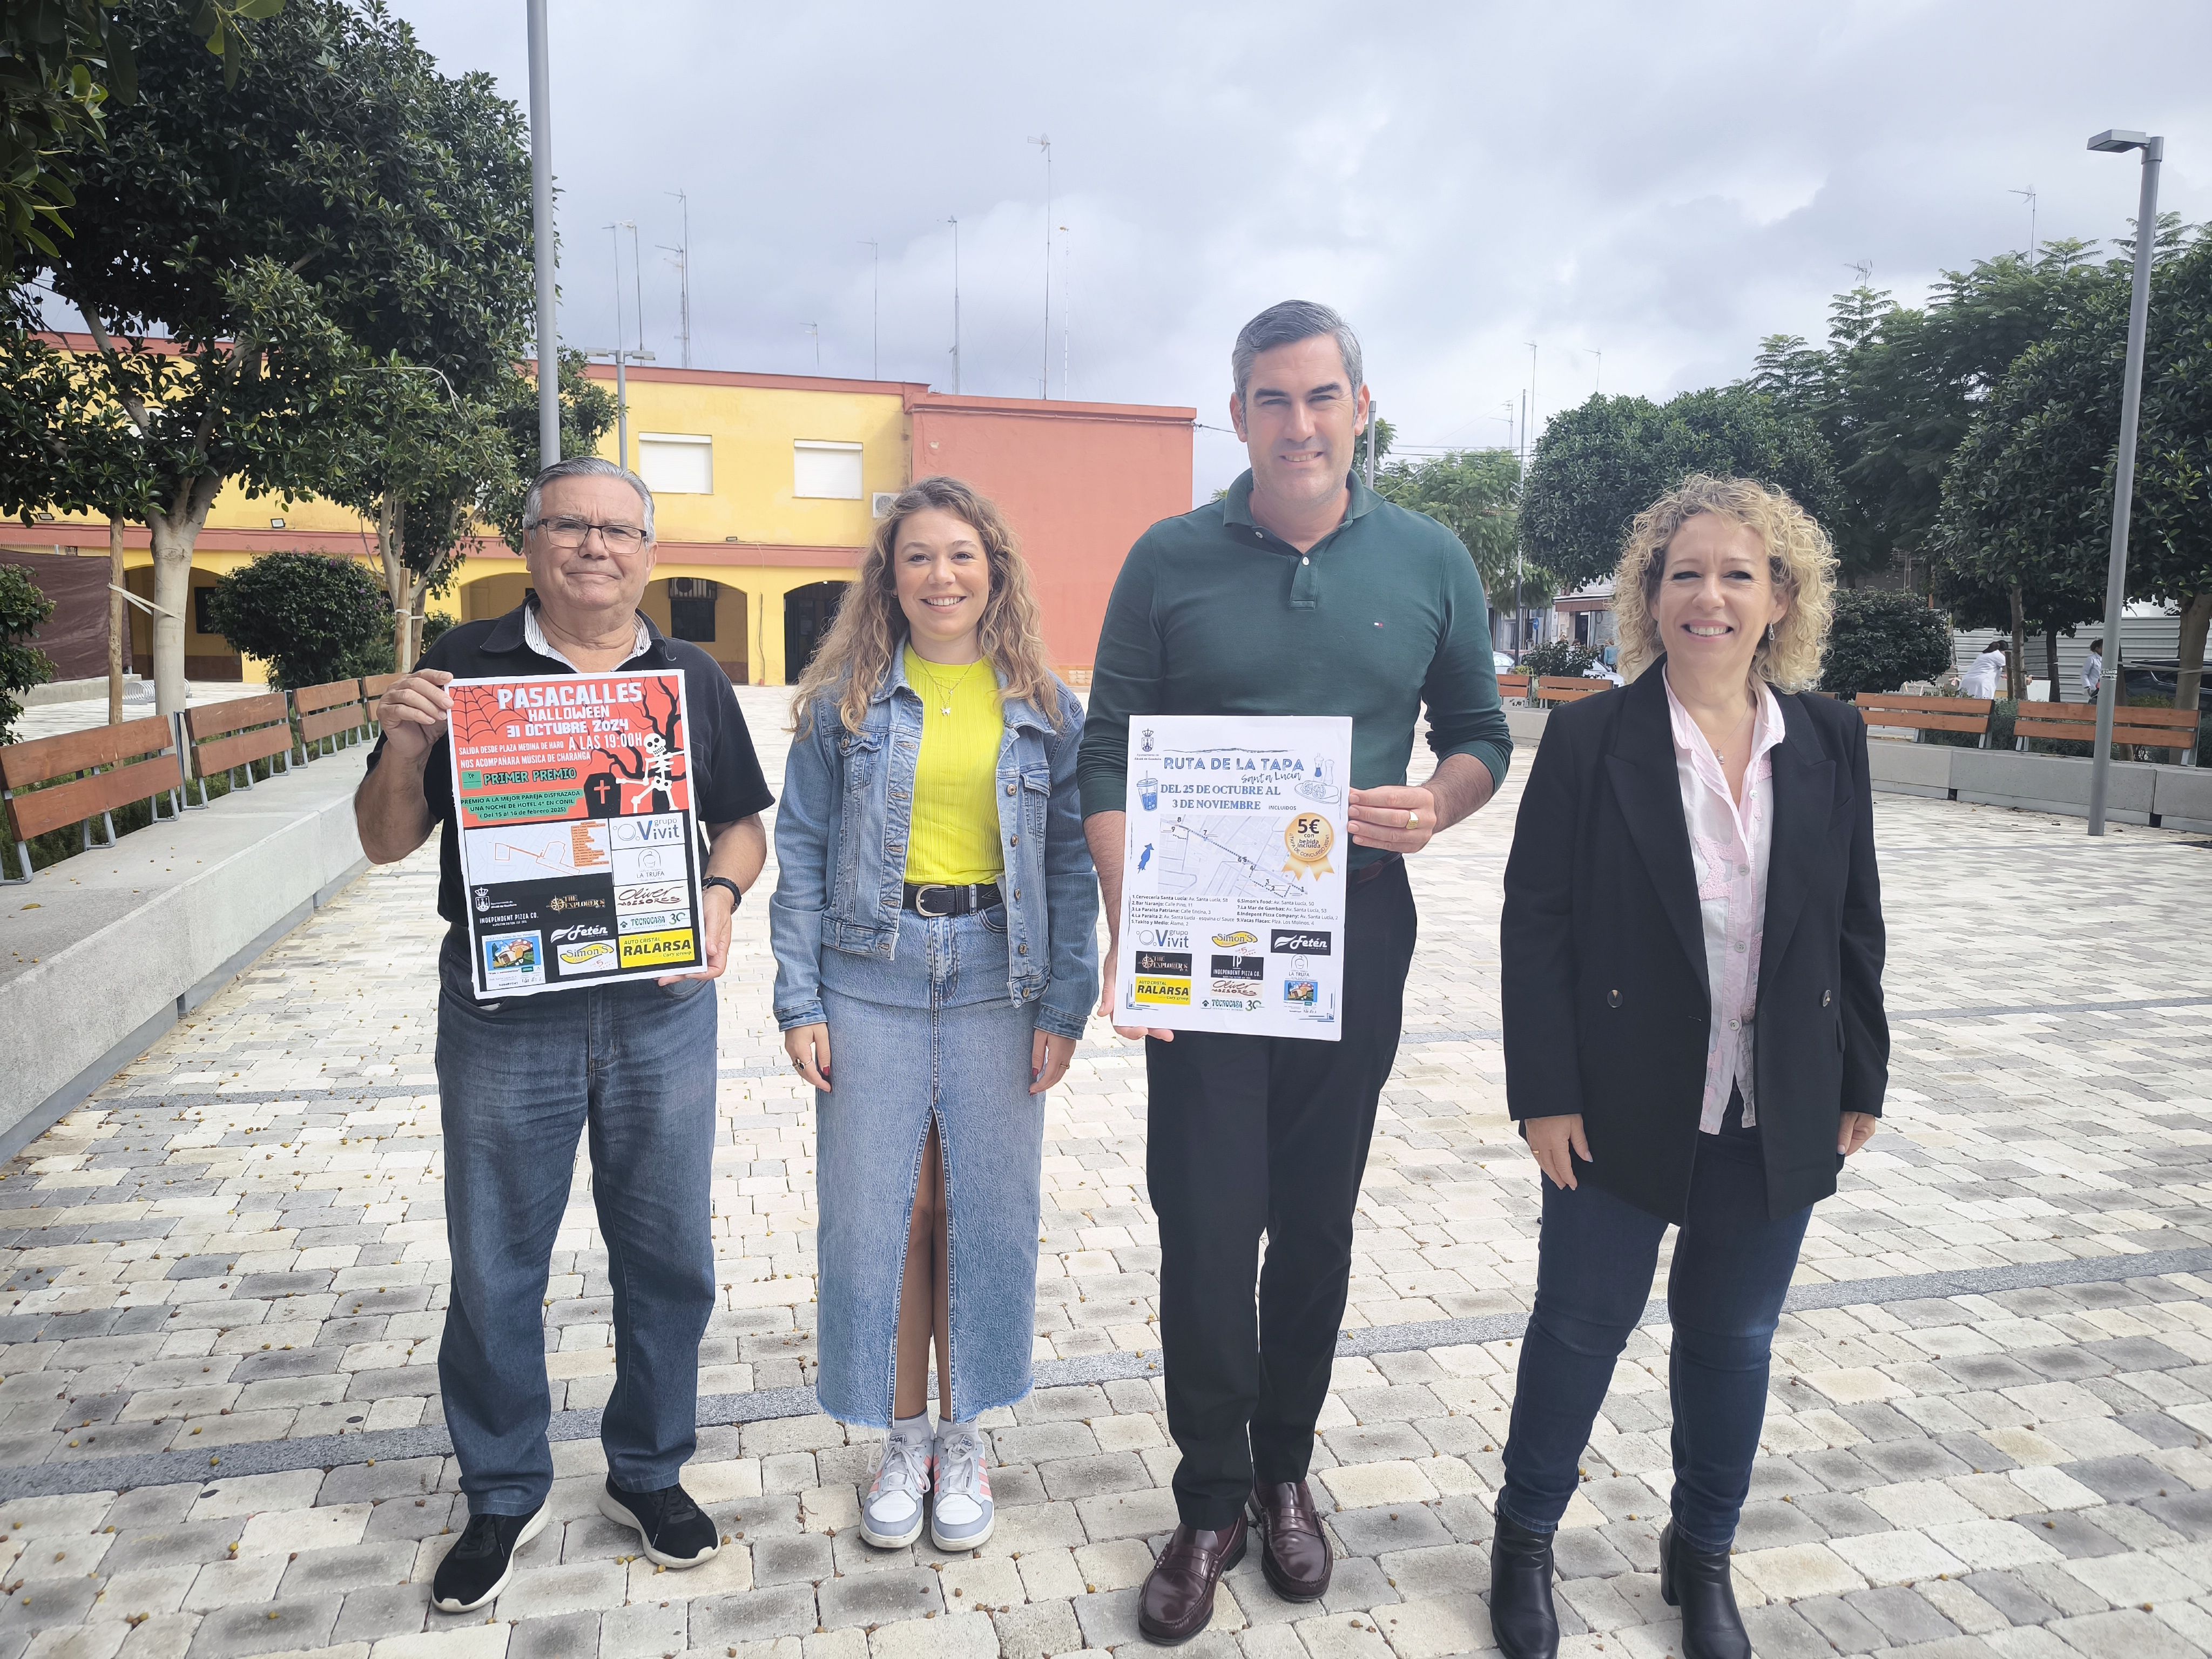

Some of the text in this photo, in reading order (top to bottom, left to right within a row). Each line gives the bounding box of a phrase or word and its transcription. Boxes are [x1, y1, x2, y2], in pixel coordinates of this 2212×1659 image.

[497, 682, 642, 710] PASACALLES
[529, 705, 610, 721] HALLOWEEN
[507, 719, 629, 738] 31 OCTUBRE 2024
[458, 747, 479, 756] SALIDA
[480, 745, 498, 753] DESDE
[500, 744, 517, 752] PLAZA
[518, 742, 539, 751] MEDINA
[549, 741, 564, 749] HARO
[569, 732, 643, 751] A LAS 19:00H
[460, 751, 591, 768] NOS ACOMPAÑARA MÚSICA DE CHARANGA
[1164, 758, 1304, 771] RUTA DE LA TAPA
[484, 768, 577, 785] PRIMER PREMIO
[1241, 772, 1301, 784] Santa Lucía
[1161, 784, 1281, 795] DEL 25 DE OCTUBRE AL
[1172, 799, 1261, 810] 3 DE NOVIEMBRE
[637, 820, 680, 840] Vivit
[654, 818, 677, 827] grupo
[1298, 819, 1320, 834] 5€
[1300, 847, 1325, 857] CONCURSO
[617, 896, 682, 906] ASESORES
[618, 886, 684, 901] Oliver
[480, 915, 513, 924] INDEPENDENT
[631, 916, 665, 926] TECNOCASA
[568, 925, 608, 941] Fetén
[1156, 929, 1189, 948] Vivit
[624, 940, 691, 956] RALARSA
[1290, 935, 1327, 950] Fetén
[1232, 955, 1242, 967] IP
[1137, 985, 1189, 995] RALARSA
[1213, 980, 1261, 989] Oliver
[1212, 1000, 1243, 1008] TECNOCASA
